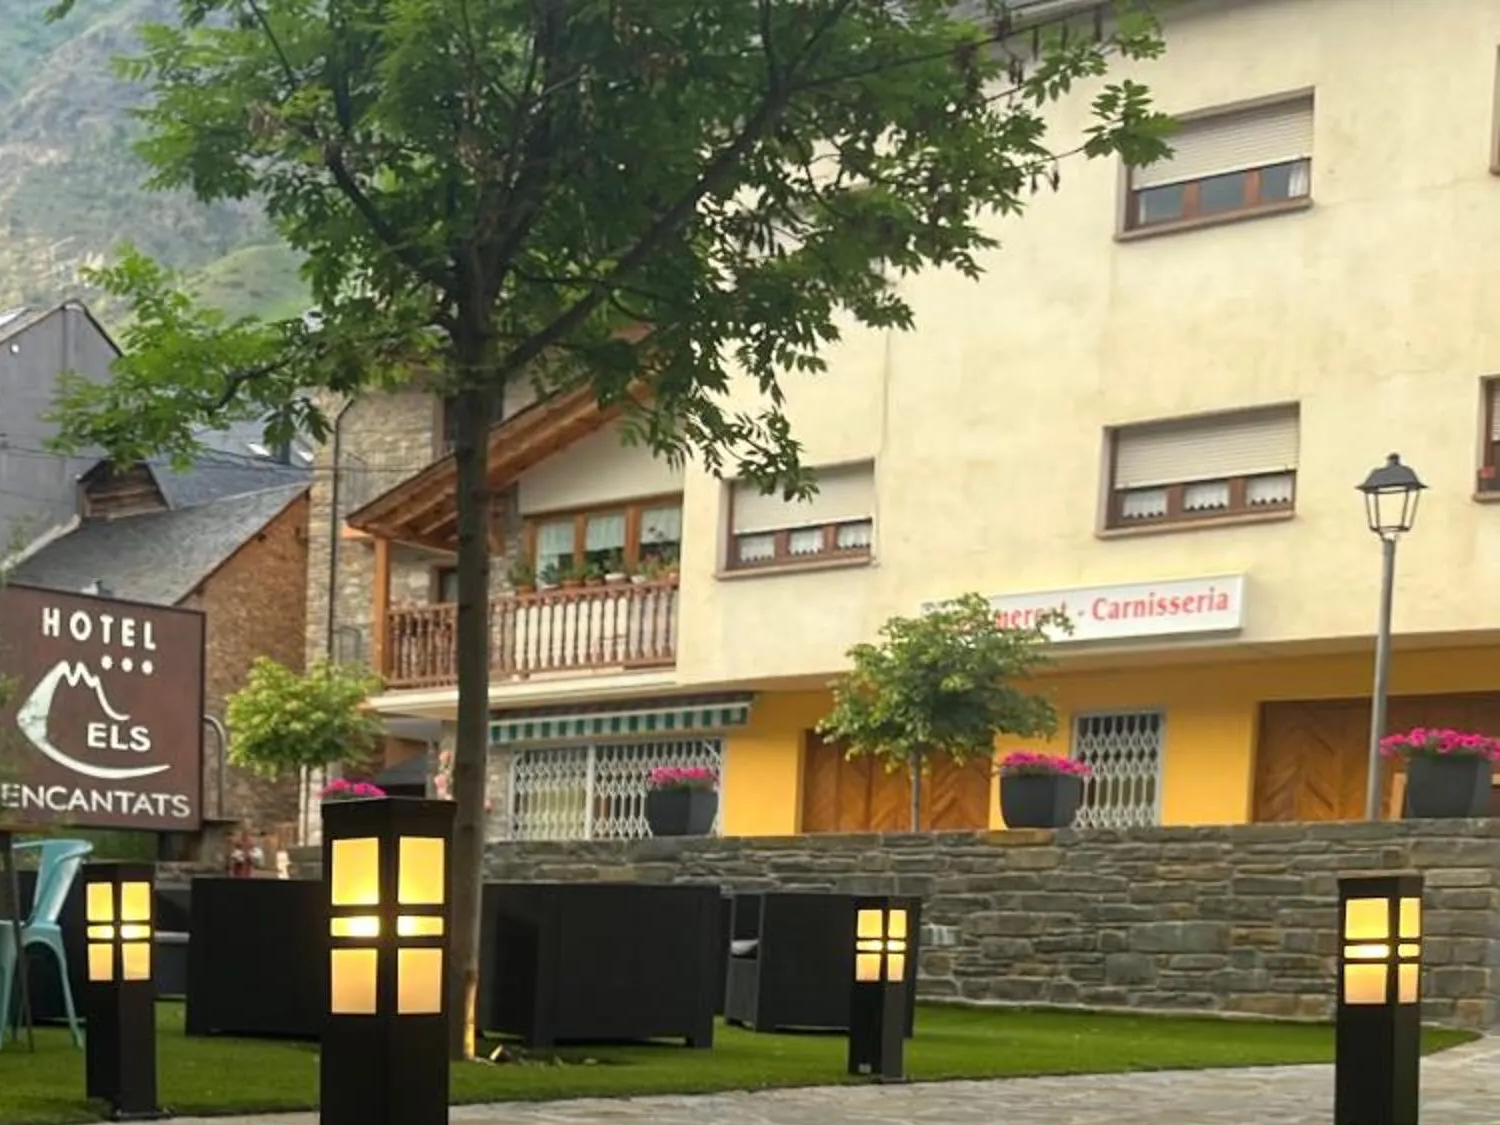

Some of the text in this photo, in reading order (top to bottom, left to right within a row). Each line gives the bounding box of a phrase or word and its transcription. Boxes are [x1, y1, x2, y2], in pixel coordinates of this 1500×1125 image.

[1091, 586, 1229, 621] Carnisseria
[42, 607, 156, 650] HOTEL
[87, 722, 151, 752] ELS
[1, 783, 190, 818] ENCANTATS
